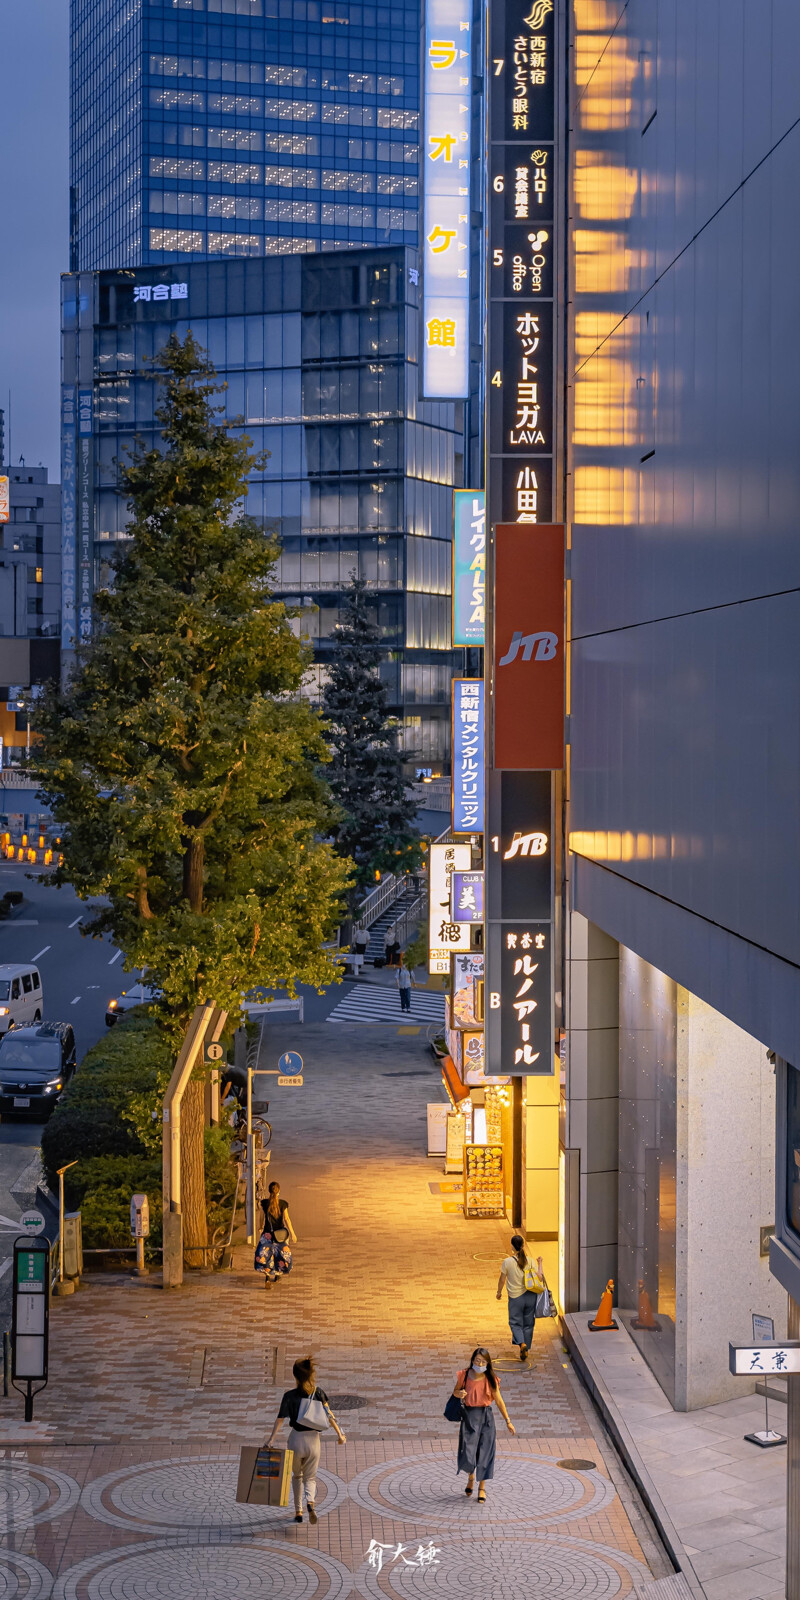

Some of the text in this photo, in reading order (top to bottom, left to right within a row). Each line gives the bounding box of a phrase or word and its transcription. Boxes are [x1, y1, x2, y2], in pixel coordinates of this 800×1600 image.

[493, 59, 504, 76] 7
[530, 36, 546, 85] 西新宿
[513, 36, 528, 130] さいとう眼科
[493, 175, 504, 193] 6
[515, 167, 529, 218] 貸会議室
[534, 168, 547, 204] ハロー
[493, 249, 503, 266] 5
[512, 255, 527, 292] office
[529, 254, 546, 292] Open
[133, 282, 189, 302] 河合塾
[491, 370, 502, 388] 4
[516, 312, 541, 430] ホットヨガ
[509, 430, 546, 444] LAVA
[499, 631, 558, 666] JTB
[460, 682, 480, 827] 西新宿メンタルクリニック
[491, 836, 499, 852] 1
[504, 832, 548, 860] JTB
[489, 992, 501, 1009] B
[513, 954, 540, 1066] ルノアール
